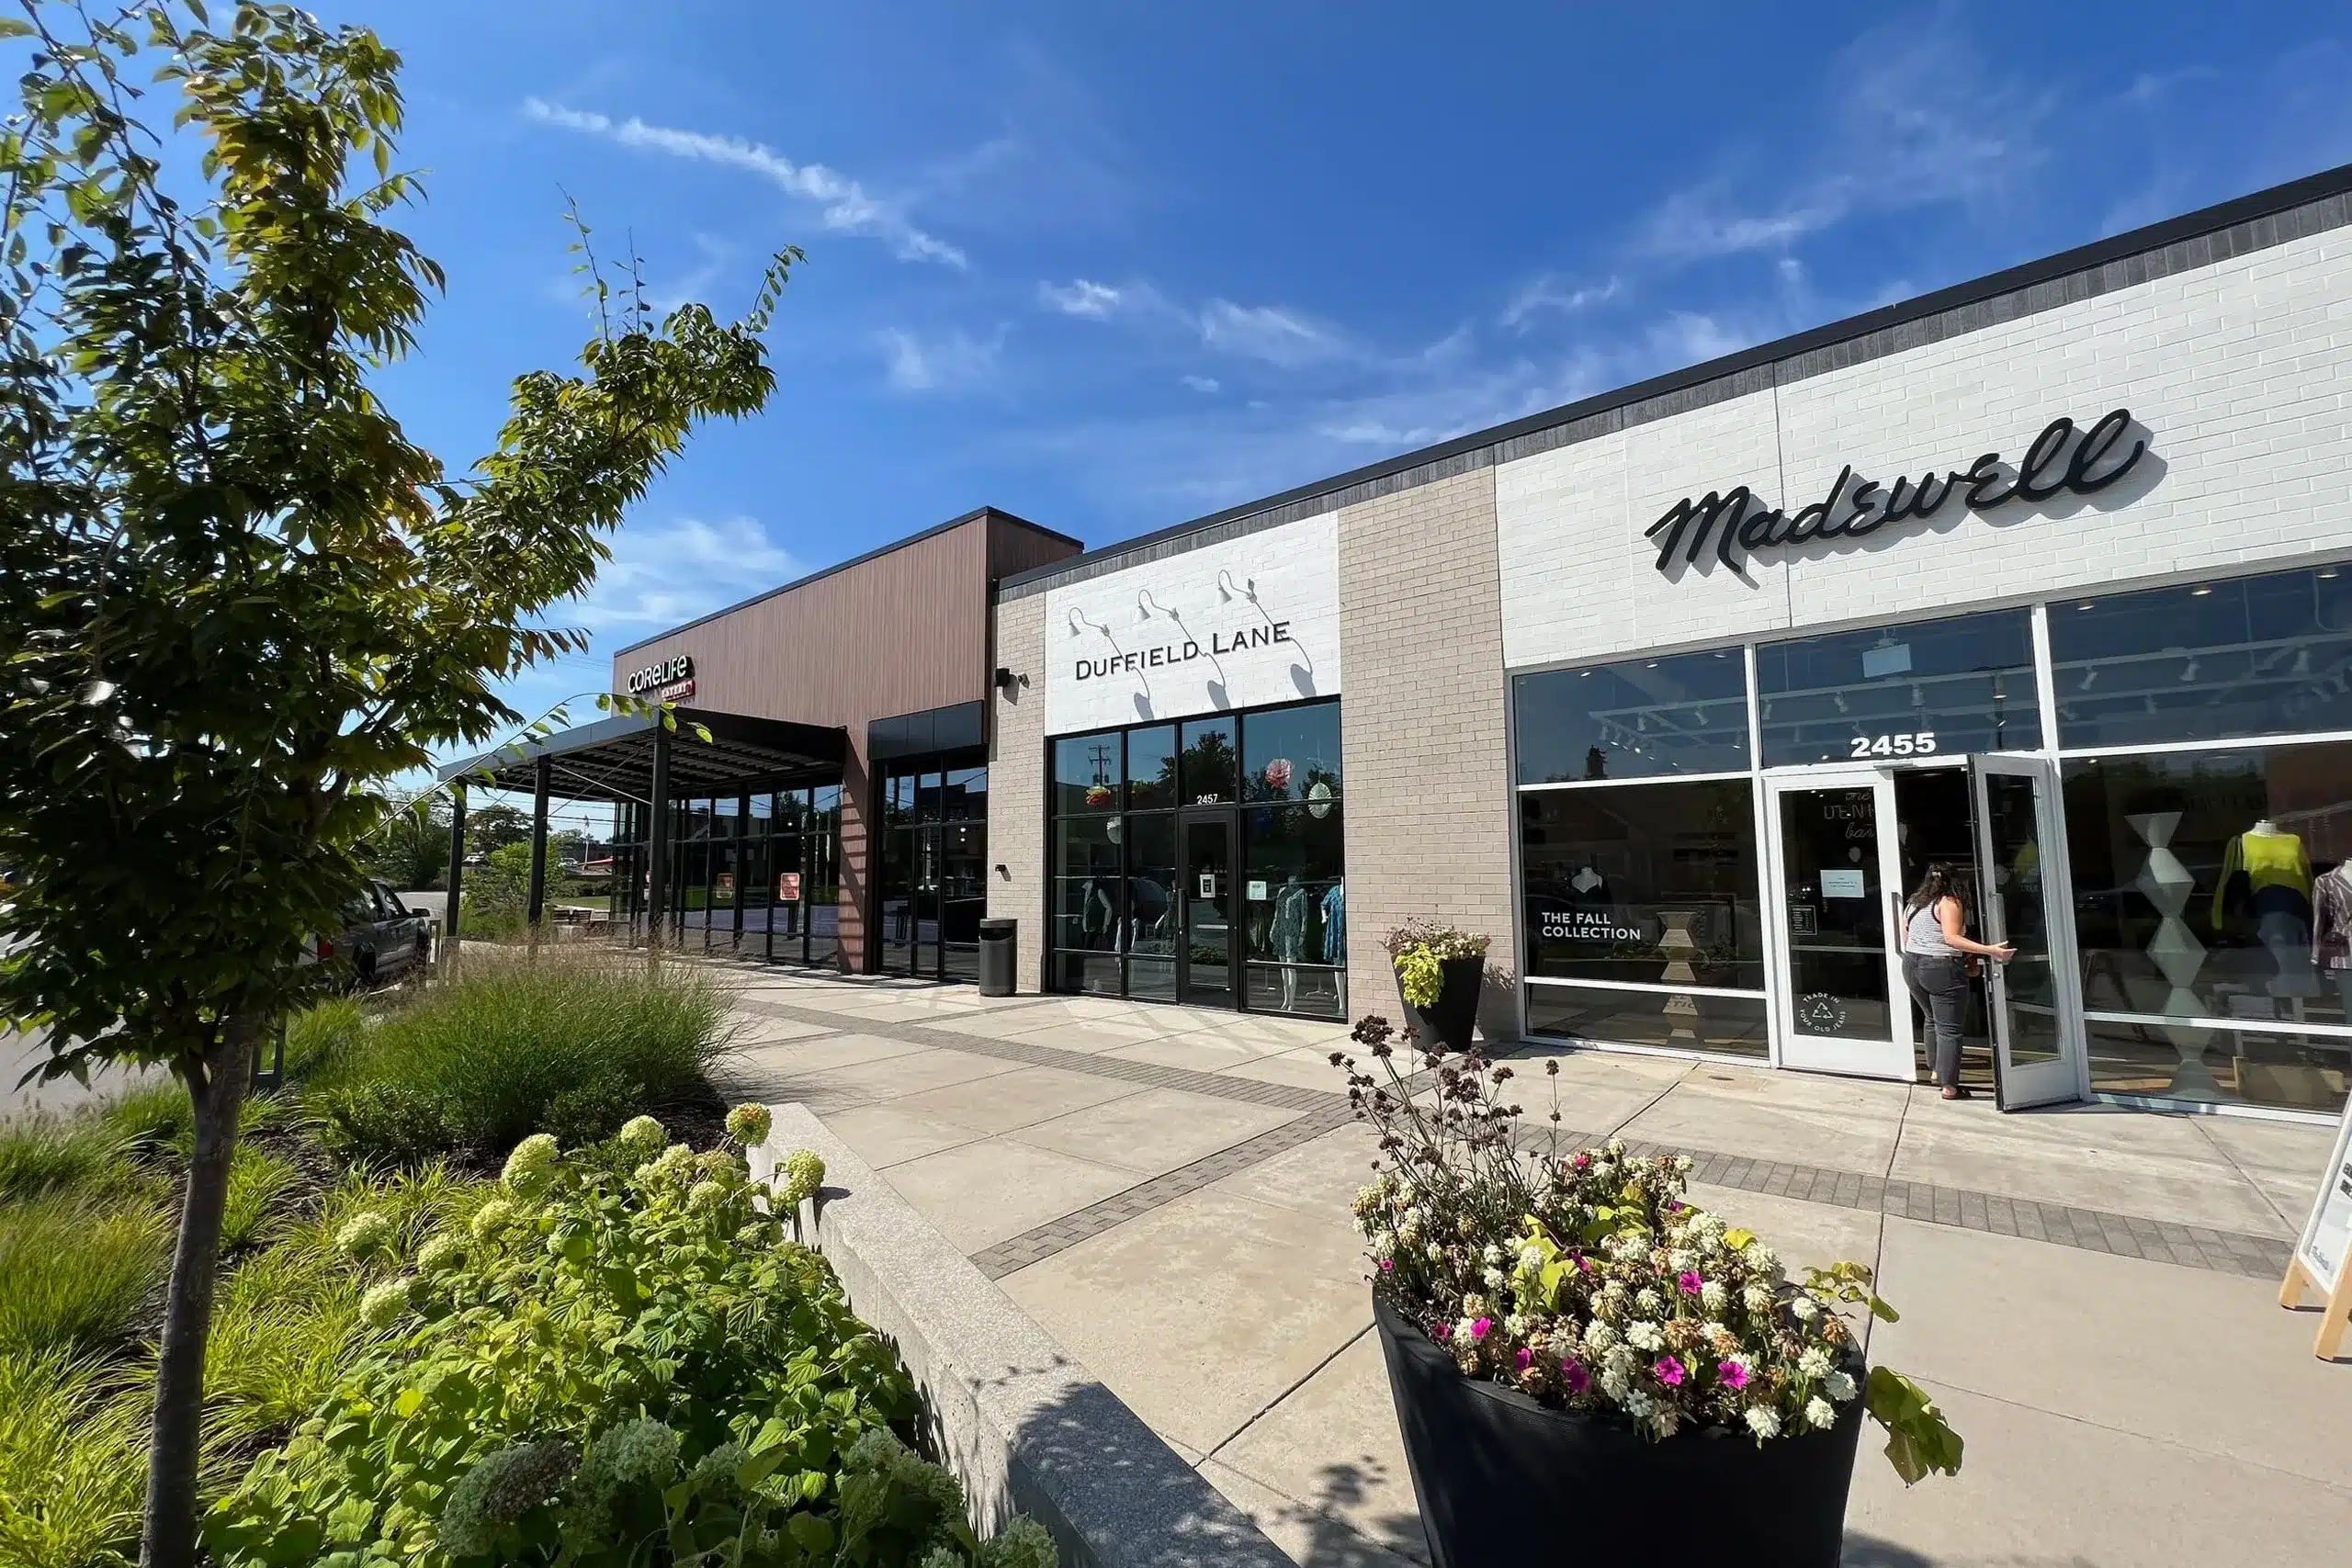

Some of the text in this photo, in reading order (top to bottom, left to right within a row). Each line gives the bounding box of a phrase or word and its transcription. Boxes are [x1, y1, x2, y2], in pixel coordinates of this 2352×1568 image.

[1645, 408, 2144, 573] Madewell
[1076, 621, 1290, 682] DUFFIELD LANE
[1850, 732, 1937, 758] 2455
[1196, 793, 1218, 805] 2457
[1542, 912, 1611, 925] THE FALL
[1542, 926, 1641, 941] COLLECTION
[1803, 992, 1840, 1004] TRADE IN
[1800, 1009, 1813, 1027] YOUR
[1833, 1010, 1847, 1030] JEANS
